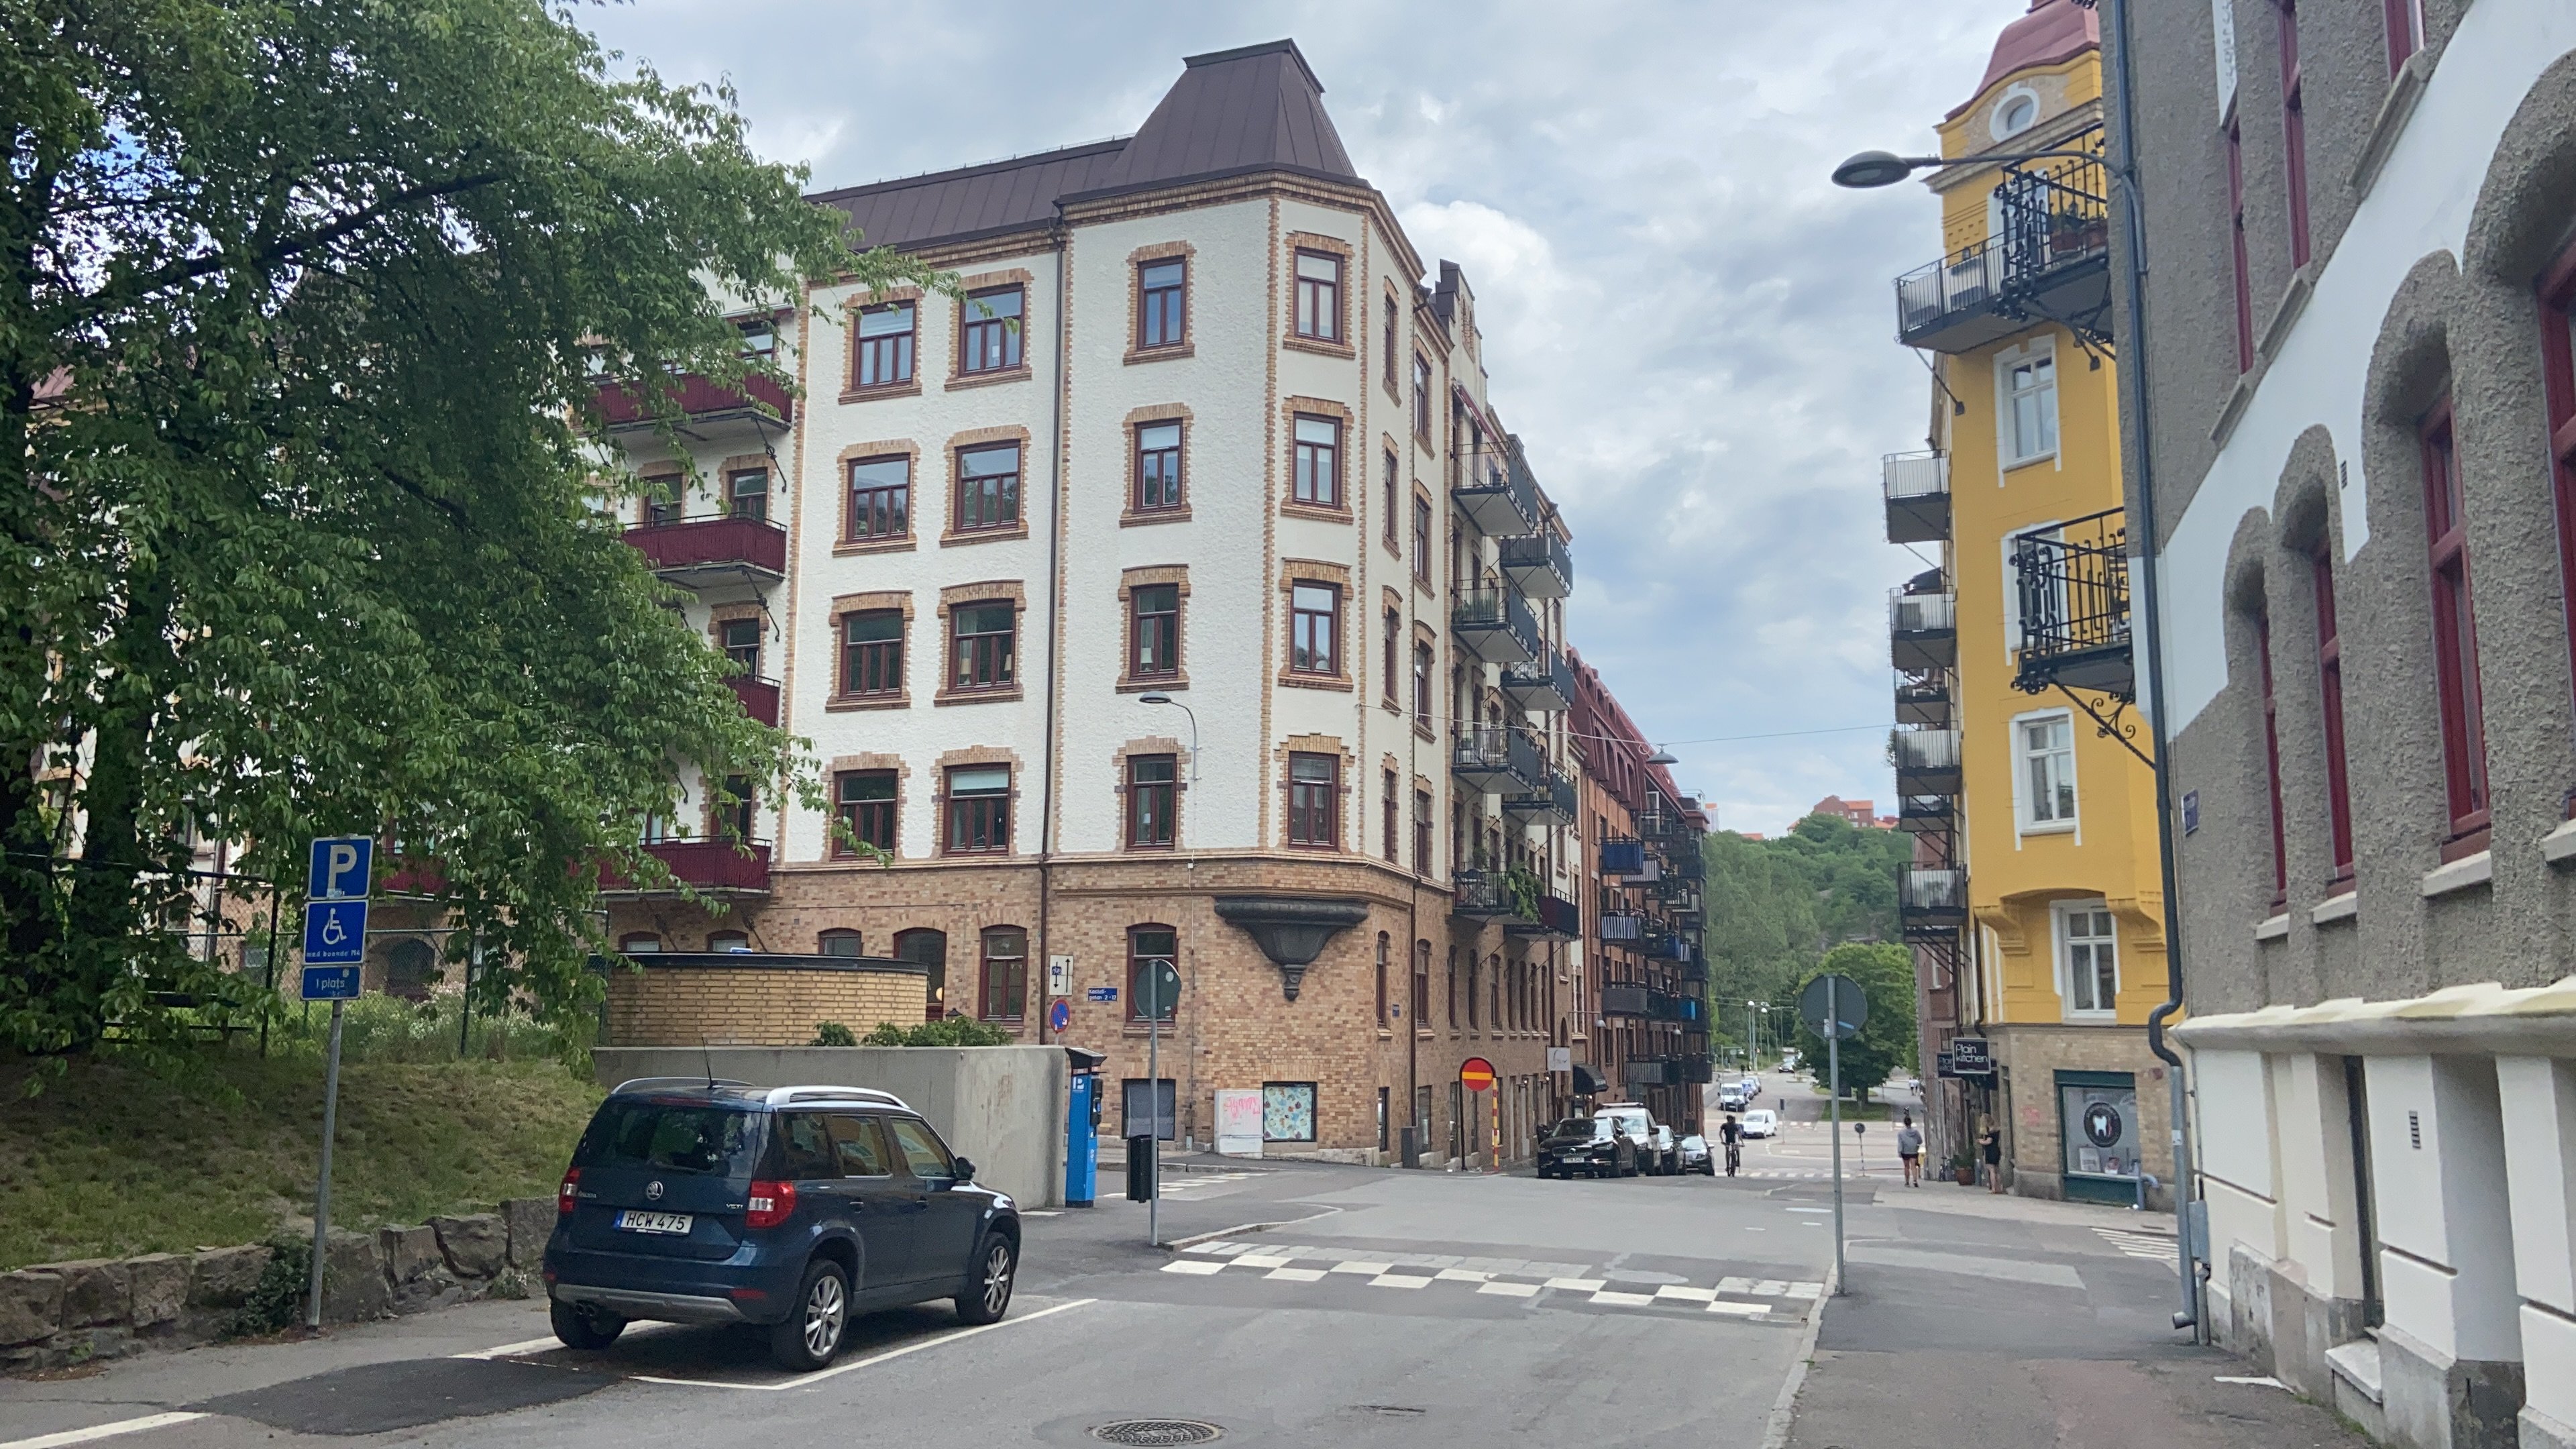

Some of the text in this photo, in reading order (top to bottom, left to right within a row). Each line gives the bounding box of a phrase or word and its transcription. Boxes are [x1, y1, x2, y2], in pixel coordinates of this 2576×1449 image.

[327, 844, 358, 898] P
[321, 977, 345, 990] plats
[627, 1212, 686, 1230] HCW 475
